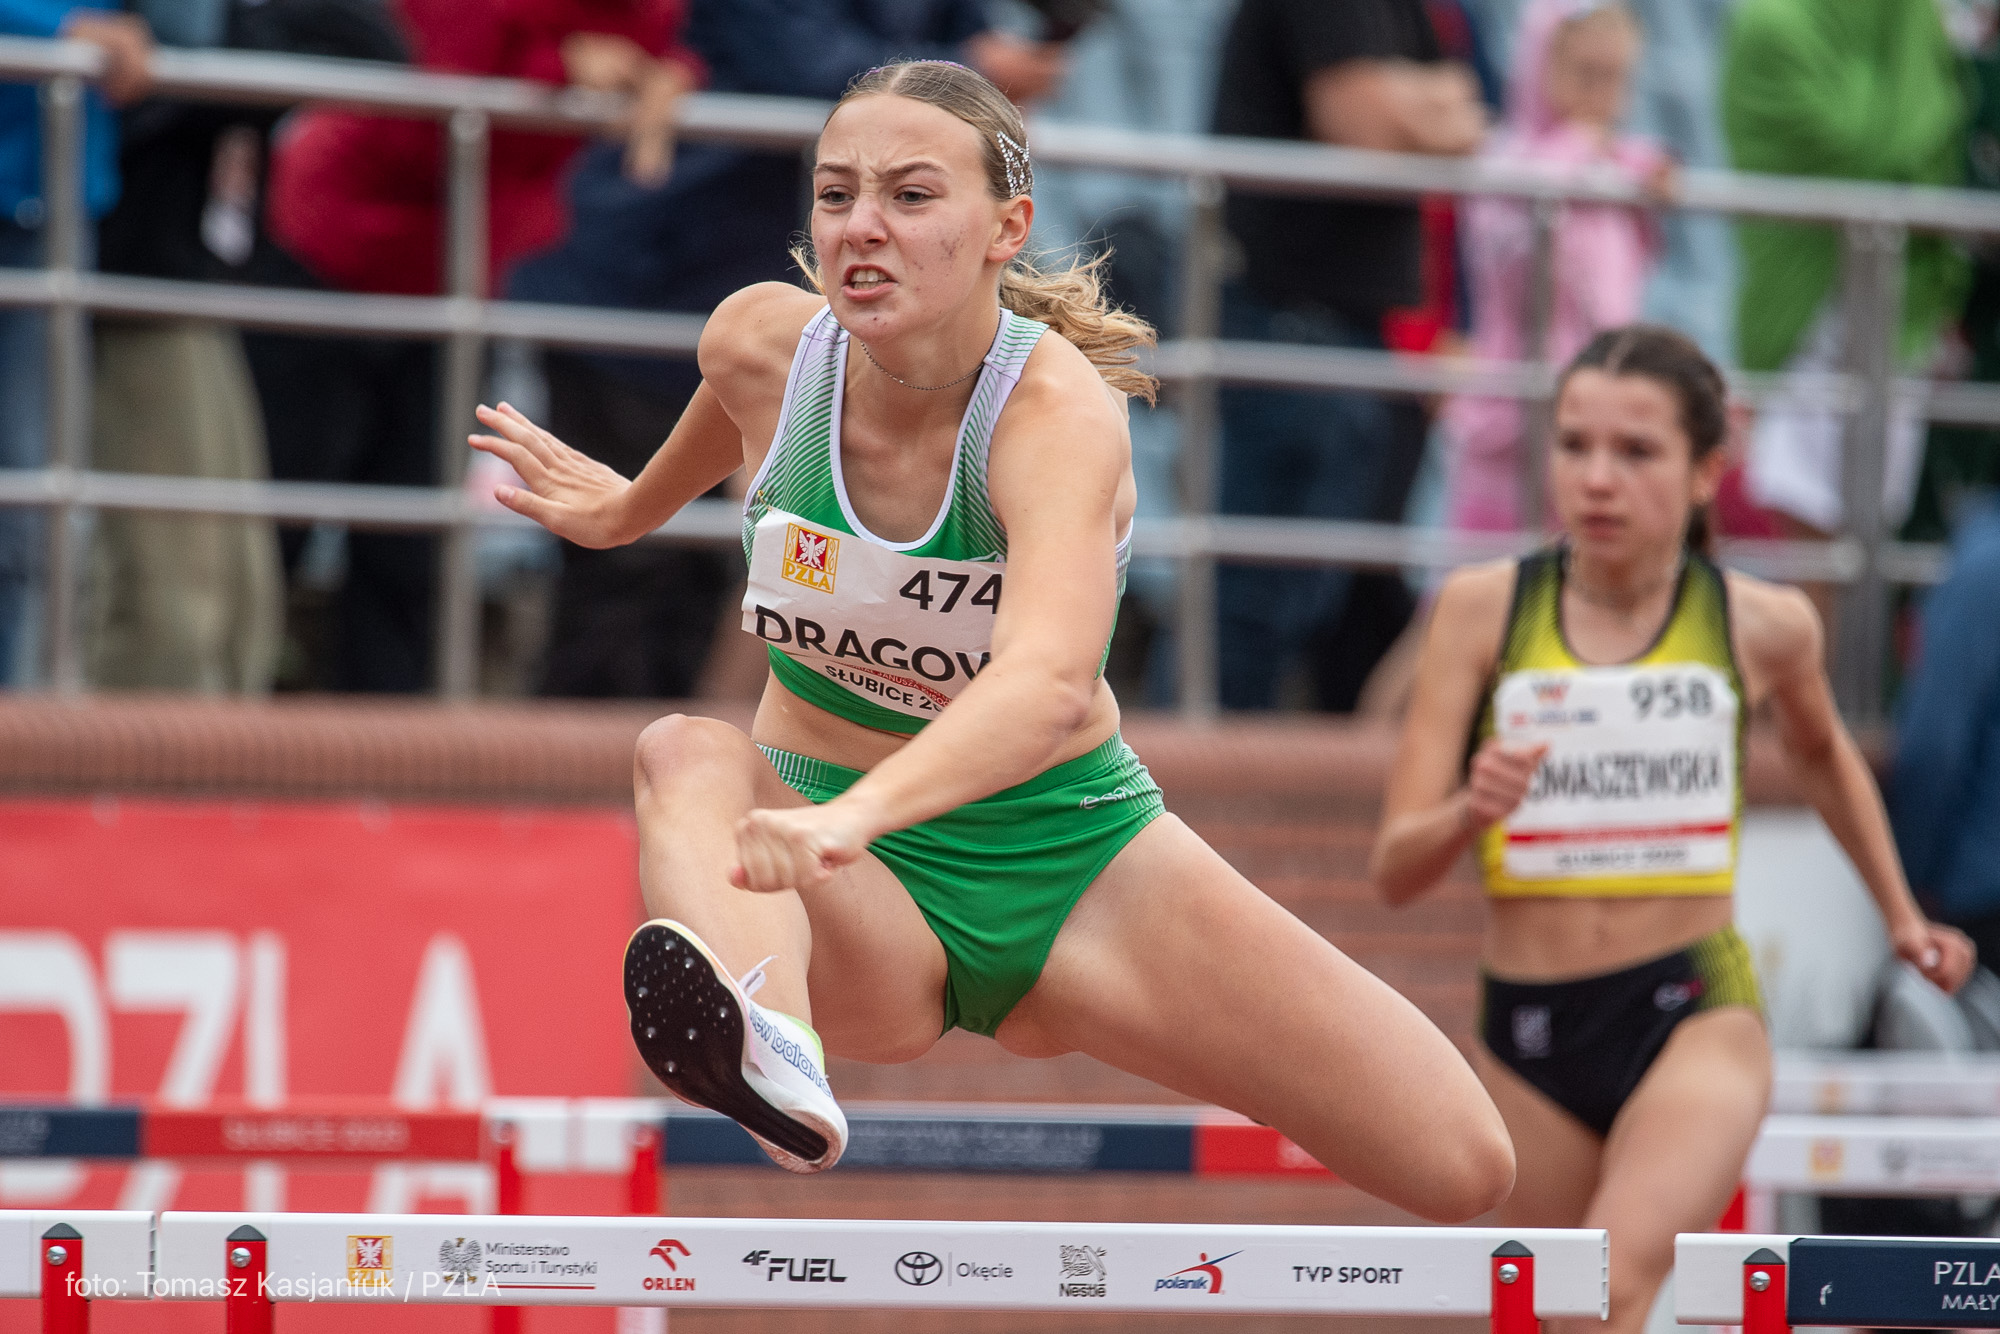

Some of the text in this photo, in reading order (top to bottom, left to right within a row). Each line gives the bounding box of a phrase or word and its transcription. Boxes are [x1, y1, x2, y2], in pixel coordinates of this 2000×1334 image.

[784, 562, 831, 591] PZLA
[899, 569, 1003, 615] 474
[825, 665, 914, 707] SŁUBICE
[1630, 674, 1713, 720] 958
[485, 1242, 570, 1256] Ministerstwo
[485, 1260, 529, 1275] Sportu
[538, 1260, 598, 1276] Turystyki
[768, 1258, 848, 1282] FUEL
[956, 1261, 1014, 1280] Okęcie
[1293, 1265, 1403, 1285] TVP SPORT
[1934, 1261, 2000, 1286] PZLA
[642, 1277, 695, 1291] ORLEN
[1154, 1276, 1208, 1292] polanik
[1941, 1294, 2000, 1311] MAŁY
